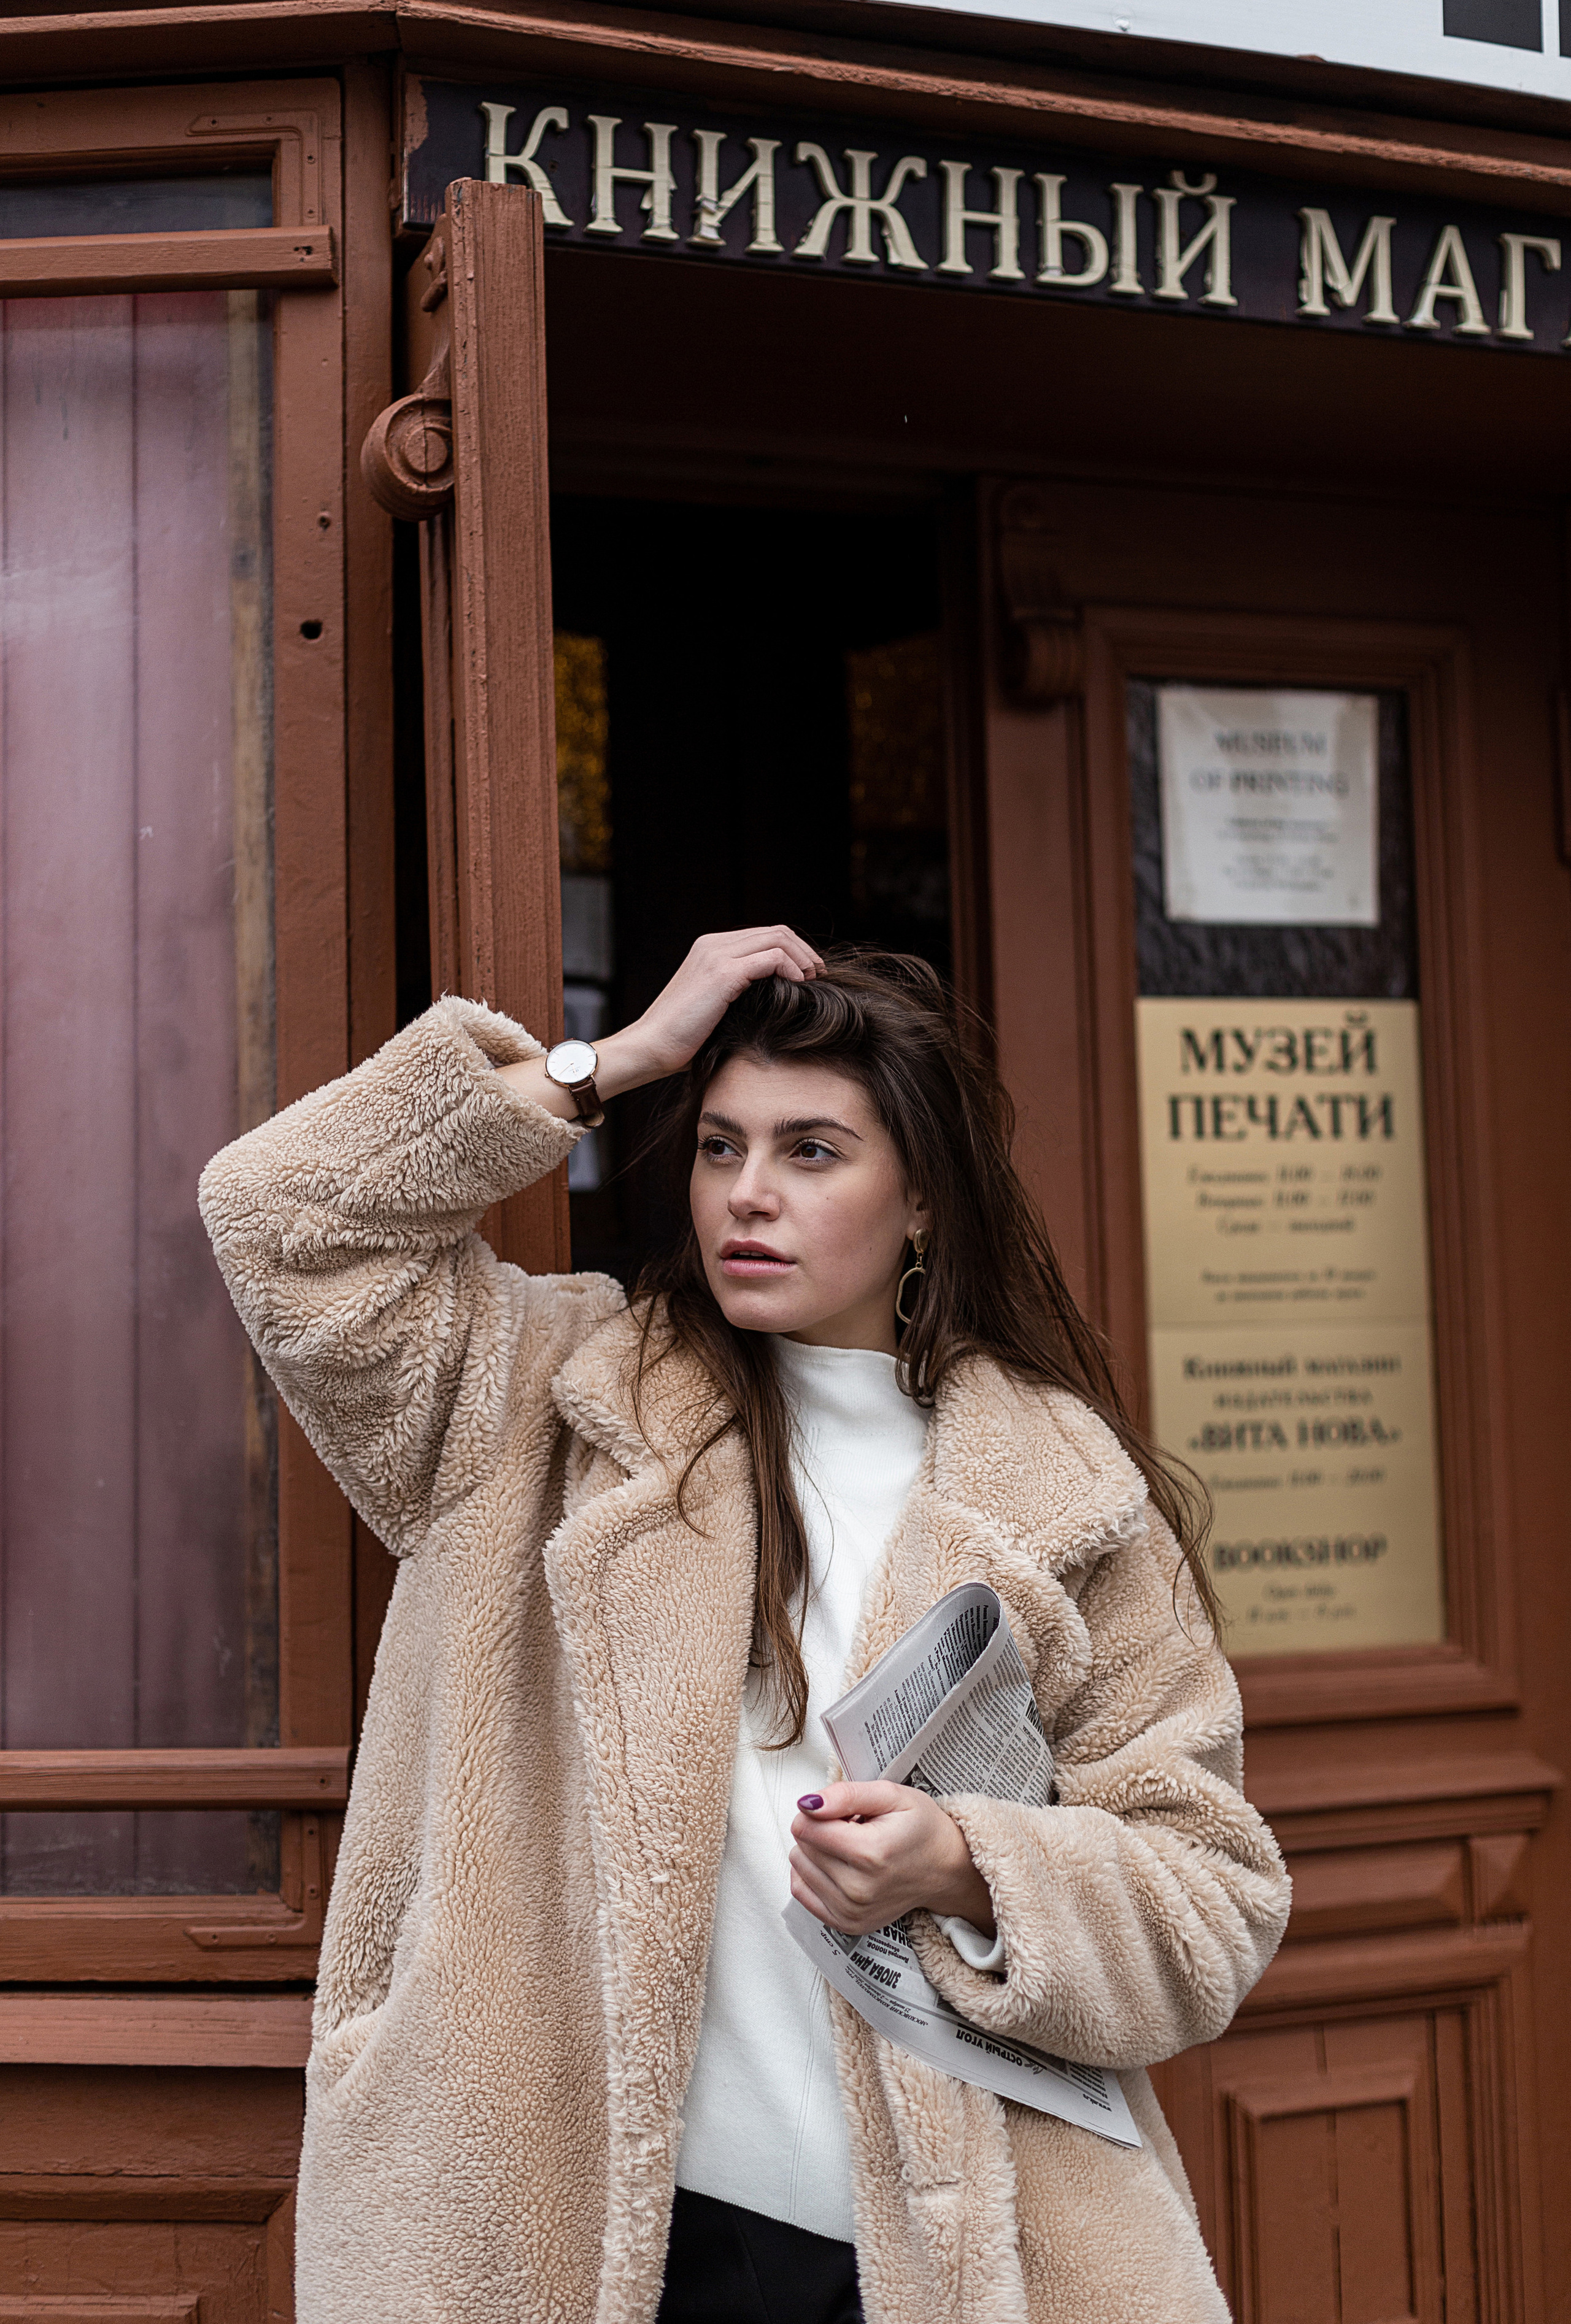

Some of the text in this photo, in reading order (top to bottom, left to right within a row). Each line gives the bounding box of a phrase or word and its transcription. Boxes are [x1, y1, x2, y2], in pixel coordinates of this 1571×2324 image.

[477, 100, 1571, 350] КНИЖНЫЙ МАГ
[1179, 1010, 1377, 1076] МУЗЕЙ
[1168, 1092, 1395, 1142] ПЕЧАТИ
[1214, 1537, 1386, 1571] BOOKSHOP
[820, 1930, 833, 1947] стр.
[864, 1934, 909, 1963] Дмитрий ПОПОВ, обозреватель
[849, 1951, 901, 1989] ЗЛОБА ДНЯ
[854, 1974, 864, 1983] 2020
[864, 1983, 881, 1996] декабря
[889, 1999, 905, 2009] ноября
[955, 2029, 983, 2049] УГОЛ
[985, 2041, 1022, 2066] ОСТРЫЙ
